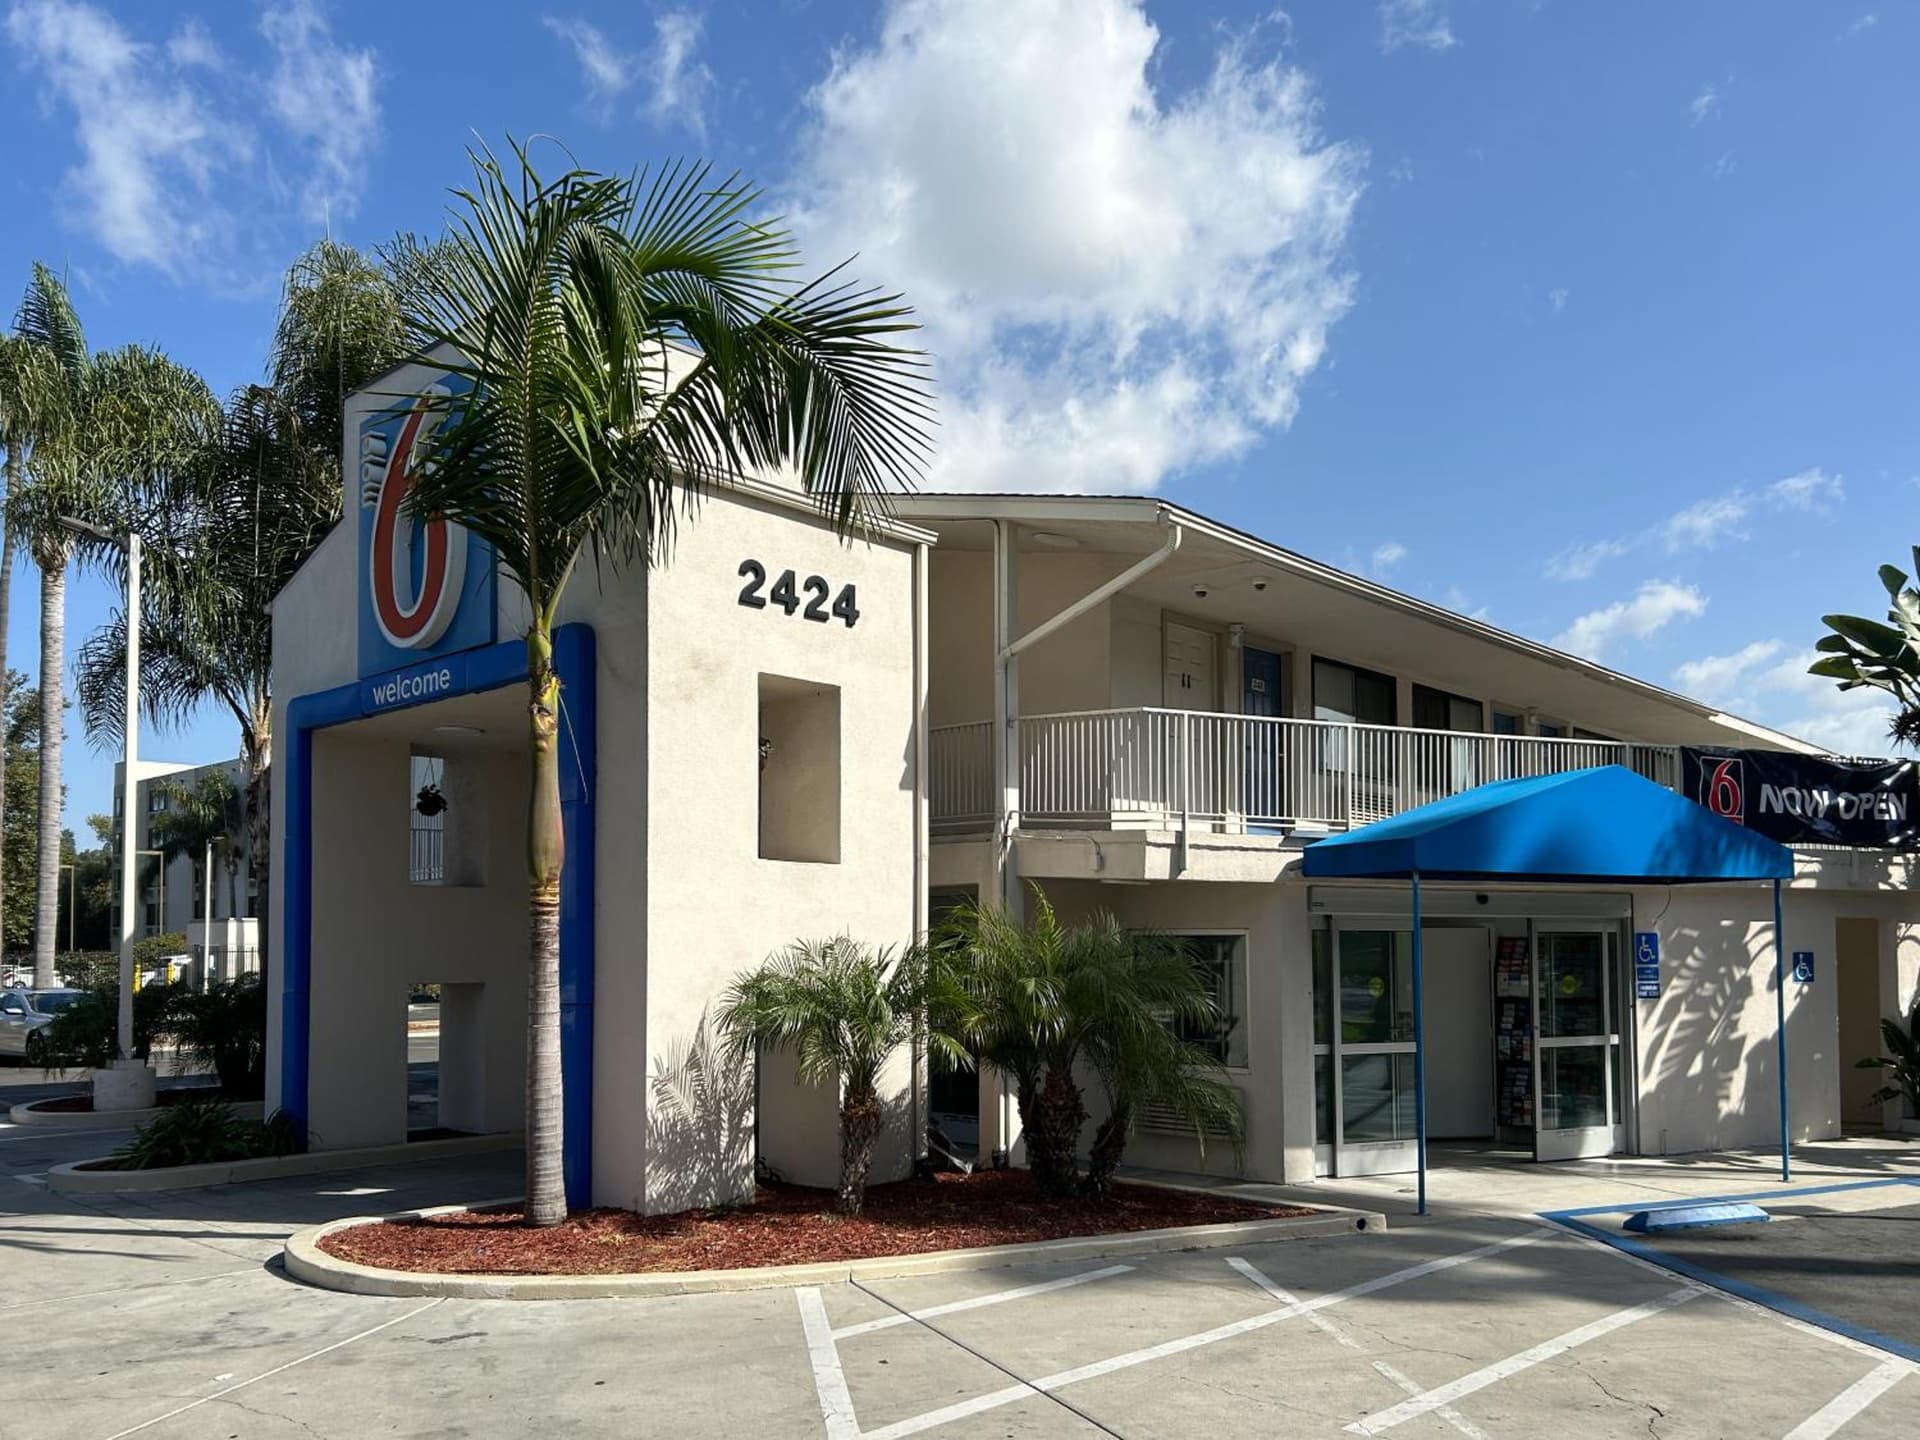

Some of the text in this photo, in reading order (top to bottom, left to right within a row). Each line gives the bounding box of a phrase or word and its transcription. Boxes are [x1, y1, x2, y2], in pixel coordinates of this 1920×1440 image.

[370, 383, 466, 649] 6
[737, 558, 860, 628] 2424
[373, 668, 450, 705] welcome
[1709, 759, 1741, 817] 6
[1759, 783, 1908, 821] NOW OPEN
